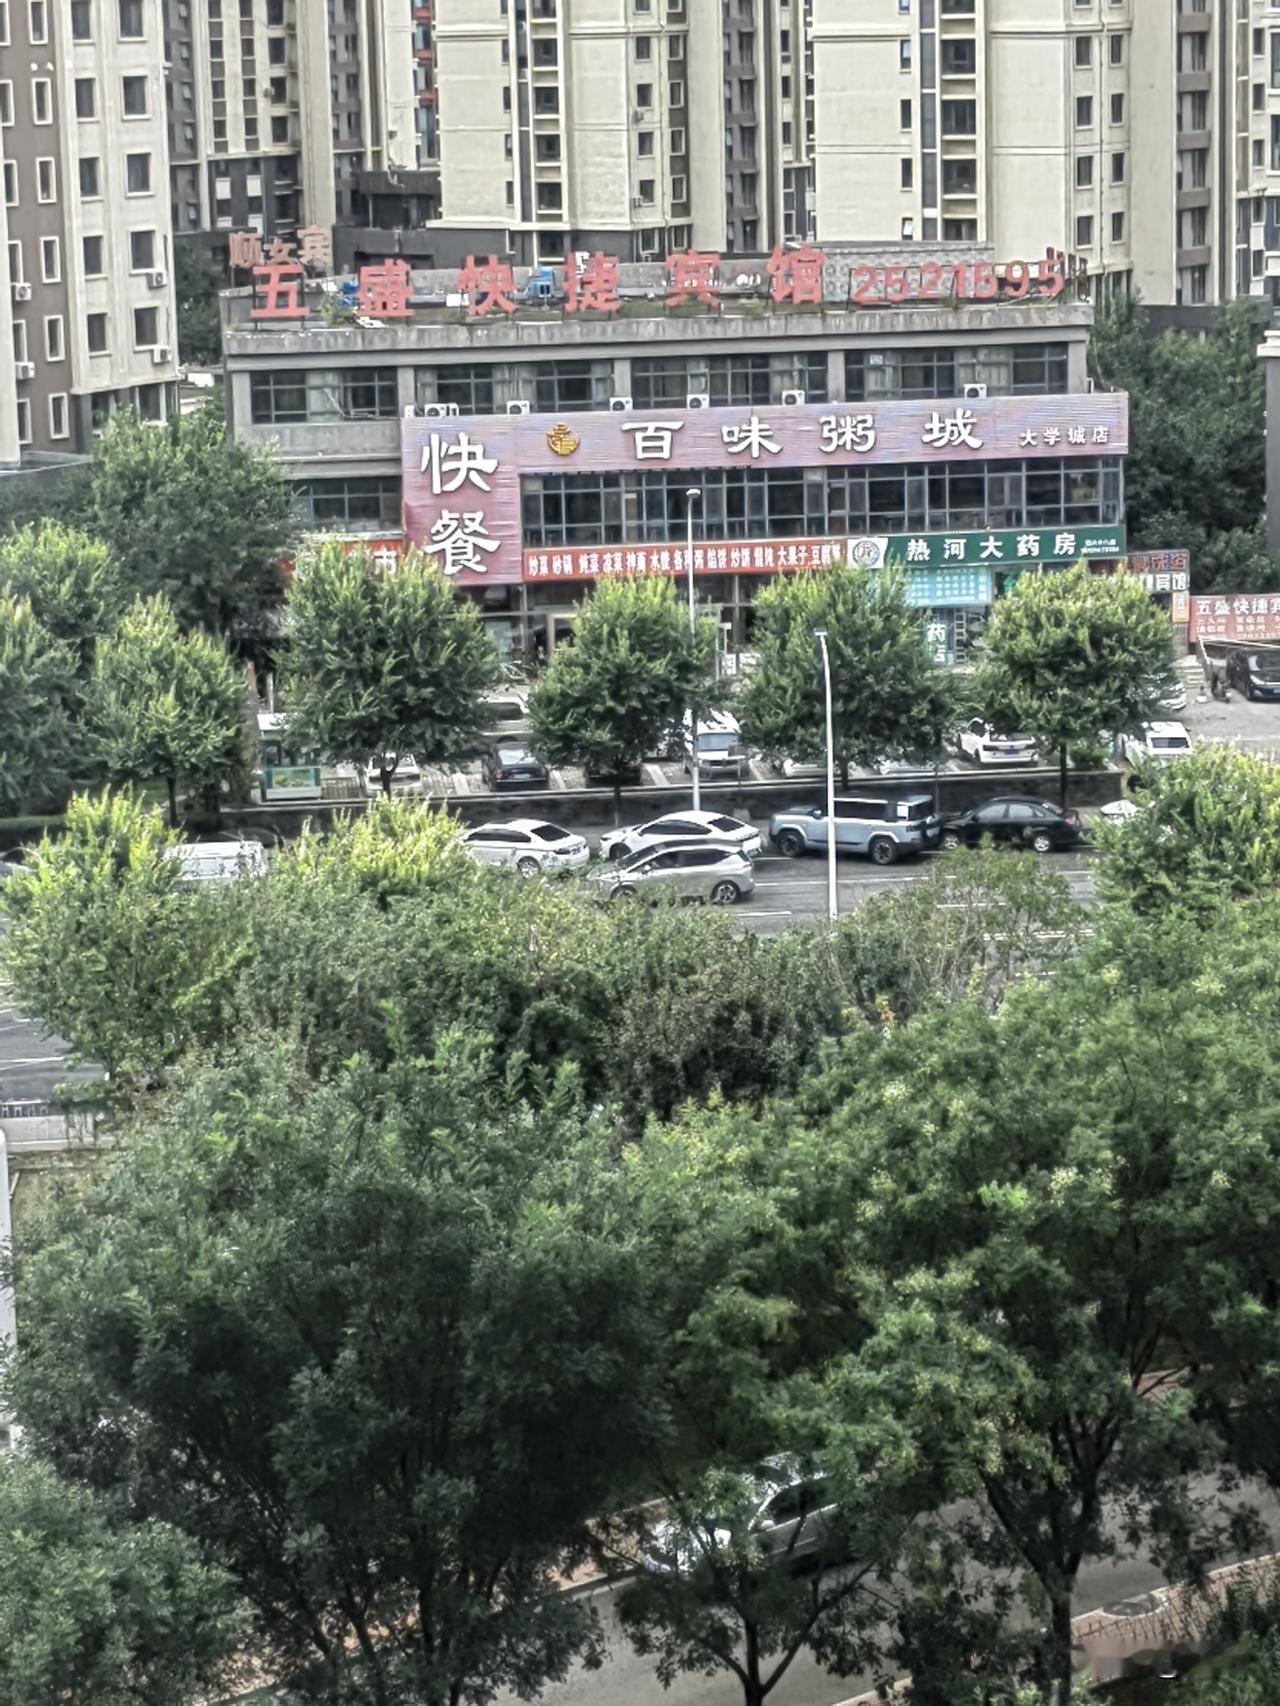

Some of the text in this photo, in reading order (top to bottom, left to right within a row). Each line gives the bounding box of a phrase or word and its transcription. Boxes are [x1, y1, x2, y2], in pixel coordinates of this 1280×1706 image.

[251, 246, 1064, 319] 五盛快捷宾馆 2521595
[621, 407, 1110, 461] 百味粥城 大学城店
[421, 432, 500, 575] 快餐
[651, 548, 670, 571] 水饺
[907, 533, 1076, 562] 热河大药房
